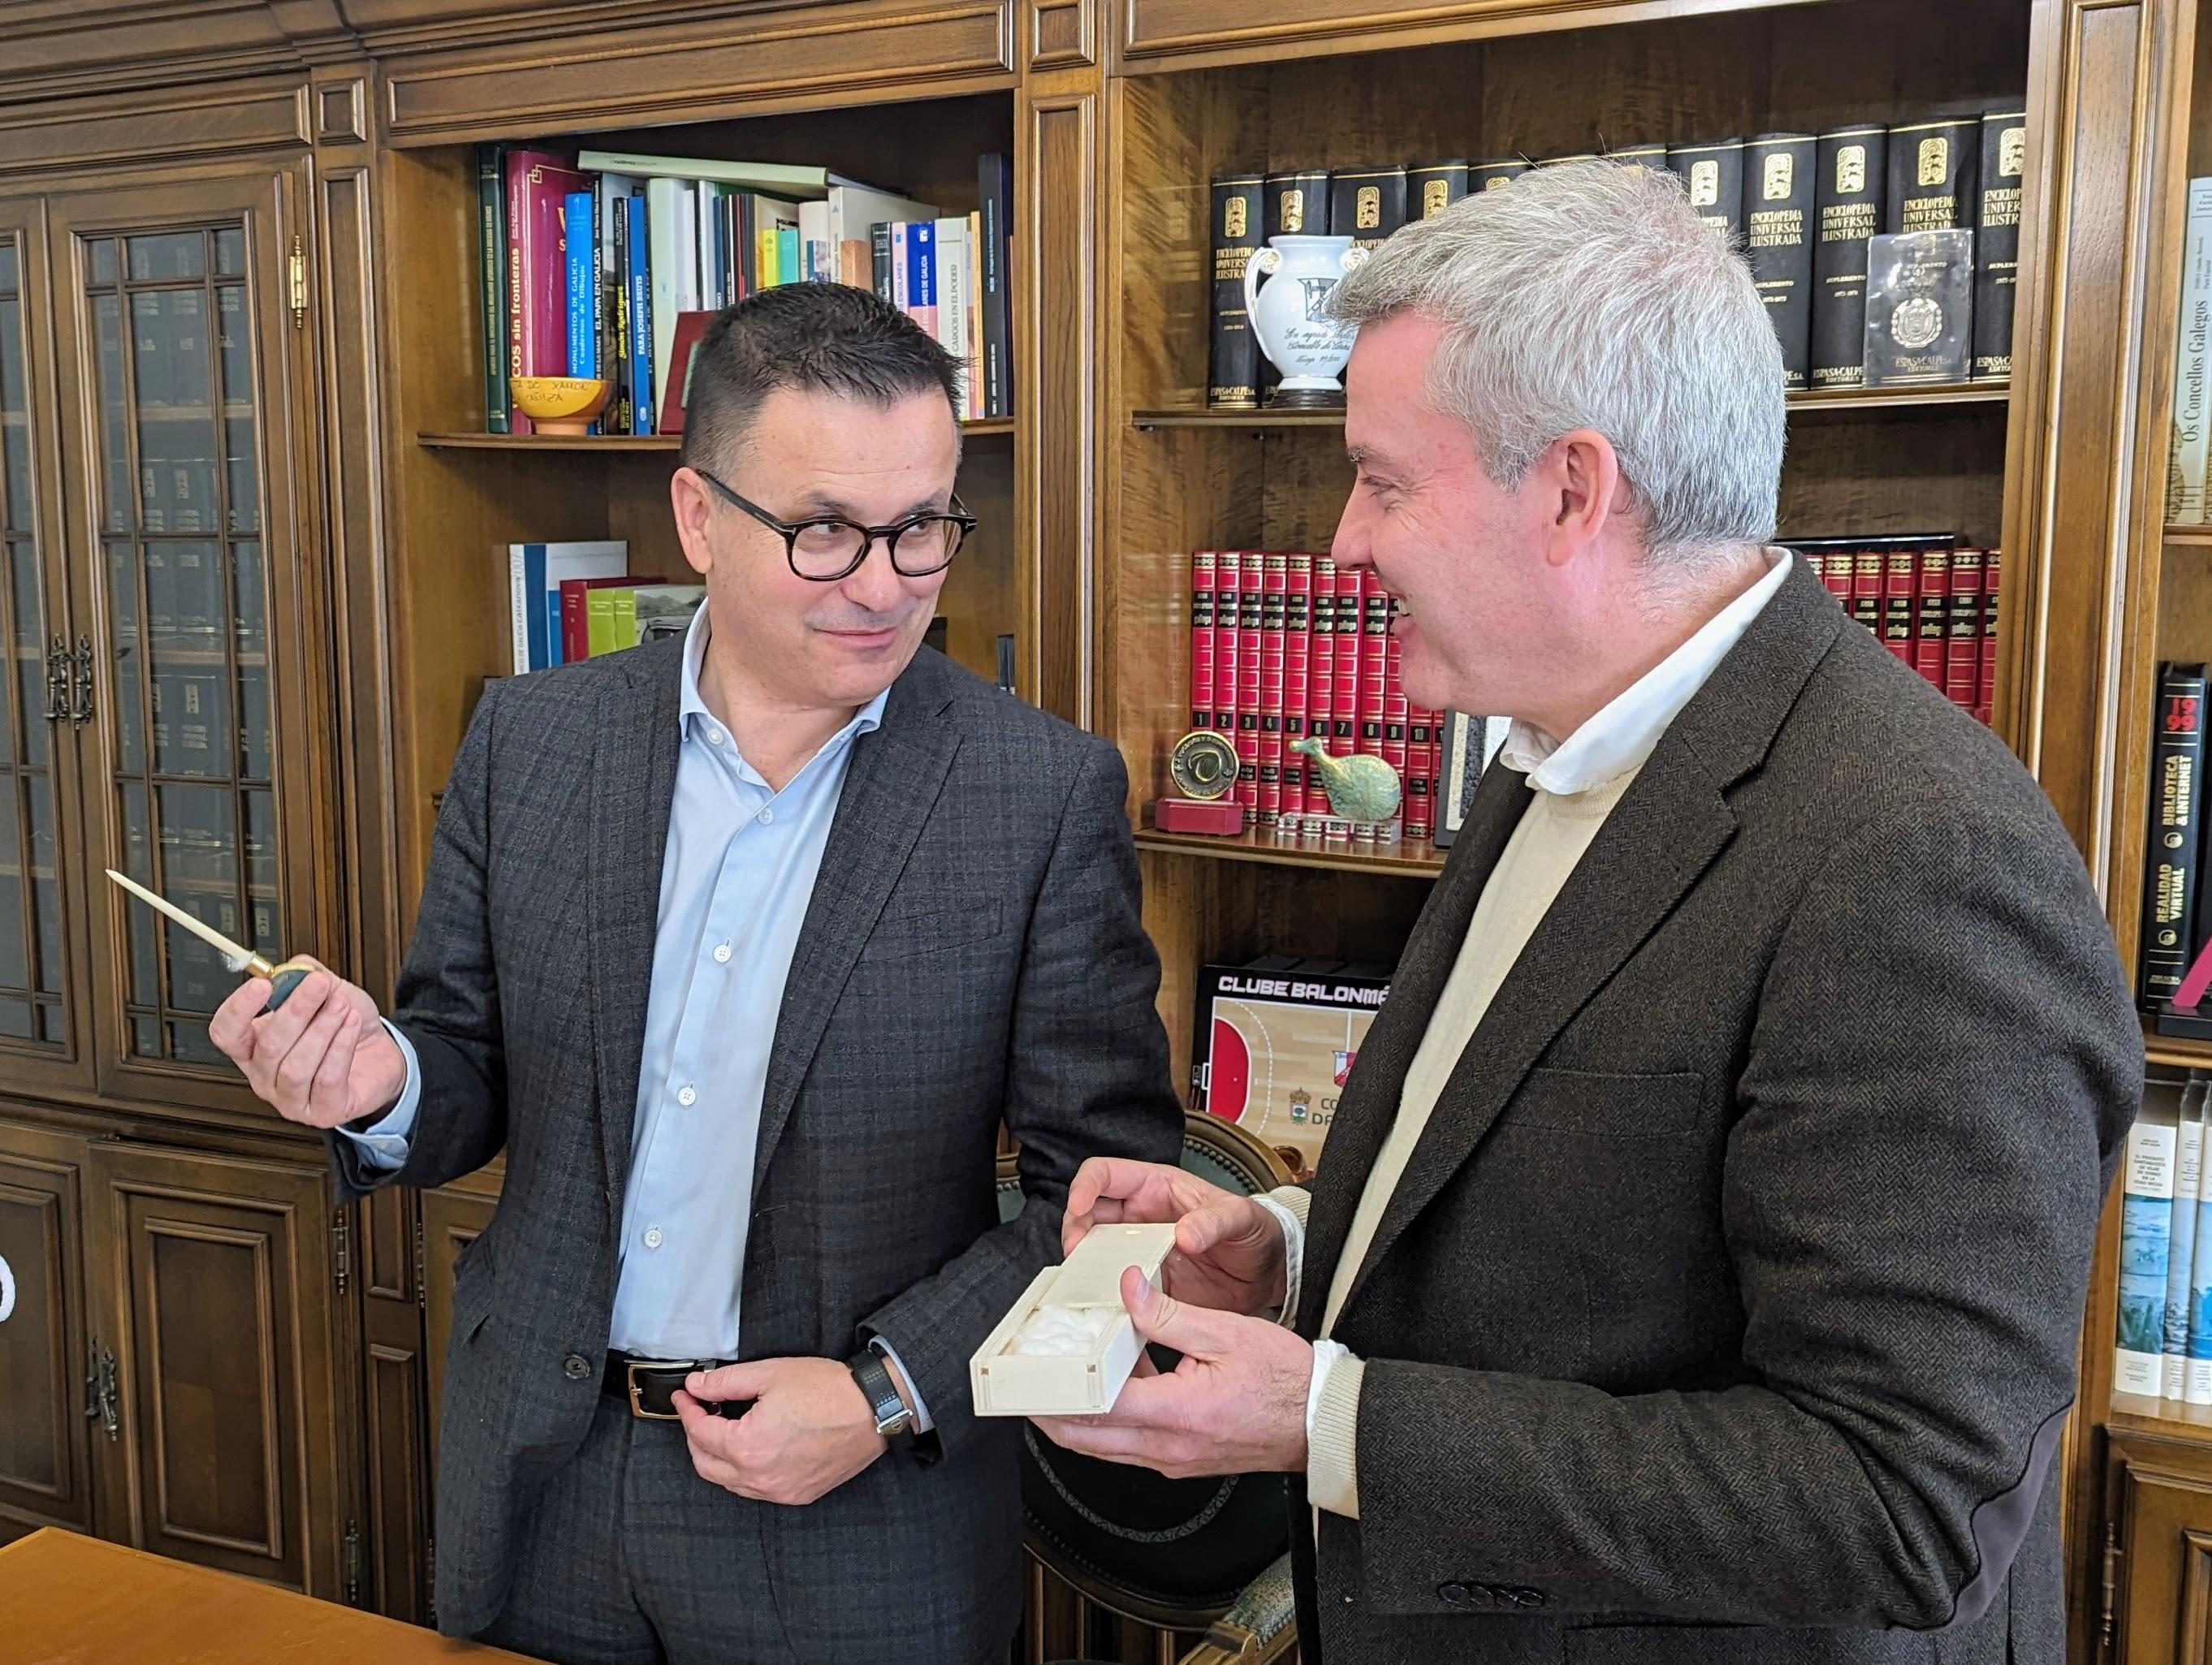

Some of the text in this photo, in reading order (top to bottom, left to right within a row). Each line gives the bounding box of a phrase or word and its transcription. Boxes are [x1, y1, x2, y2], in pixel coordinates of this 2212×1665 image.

[1984, 188, 2022, 203] ENCICLOP
[1903, 196, 1958, 210] ENCICLOPEDIA
[1983, 201, 2021, 214] UNIVER
[1750, 209, 1804, 224] ENCICLOPEDIA
[1822, 203, 1877, 218] ENCICLOPEDIA
[1903, 209, 1958, 220] UNIVERSAL
[1822, 215, 1877, 230] UNIVERSAL
[1983, 214, 2020, 227] ILUSTR
[1750, 222, 1803, 235] UNIVERSAL
[1821, 227, 1875, 242] ILUSTRADA
[1750, 233, 1803, 247] ILUSTRADA
[510, 247, 521, 315] fronteras
[922, 279, 928, 287] DE
[950, 265, 958, 293] PODER
[594, 283, 602, 295] EN
[951, 294, 958, 304] EL
[579, 304, 585, 315] de
[635, 275, 646, 356] PARA JOSEPH BEUYS
[951, 305, 959, 316] EN
[512, 318, 521, 341] sin
[594, 320, 602, 330] EL
[512, 344, 521, 378] COS
[1812, 366, 1863, 378] ESPASA-CALPE
[2182, 300, 2210, 442] Os Concellos Galegos
[2171, 697, 2197, 715] 19
[1198, 714, 1203, 726] 1
[1220, 714, 1227, 727] 2
[1244, 716, 1251, 729] 3
[1266, 717, 1272, 729] 4
[1290, 718, 1296, 731] 5
[2166, 714, 2197, 731] 99
[1315, 722, 1322, 735] 6
[1339, 722, 1346, 735] 7
[1367, 723, 1375, 735] 8
[1390, 726, 1398, 739] 9
[1414, 727, 1424, 740] 10
[2162, 755, 2178, 826] BIBLIOTECA
[2179, 755, 2192, 826] & INTERNET
[2156, 864, 2172, 923] REALIDAD
[2170, 868, 2185, 920] VIRTUAL
[1218, 976, 1391, 1006] CLUBE BALONMÁ
[1320, 1098, 1340, 1111] CO
